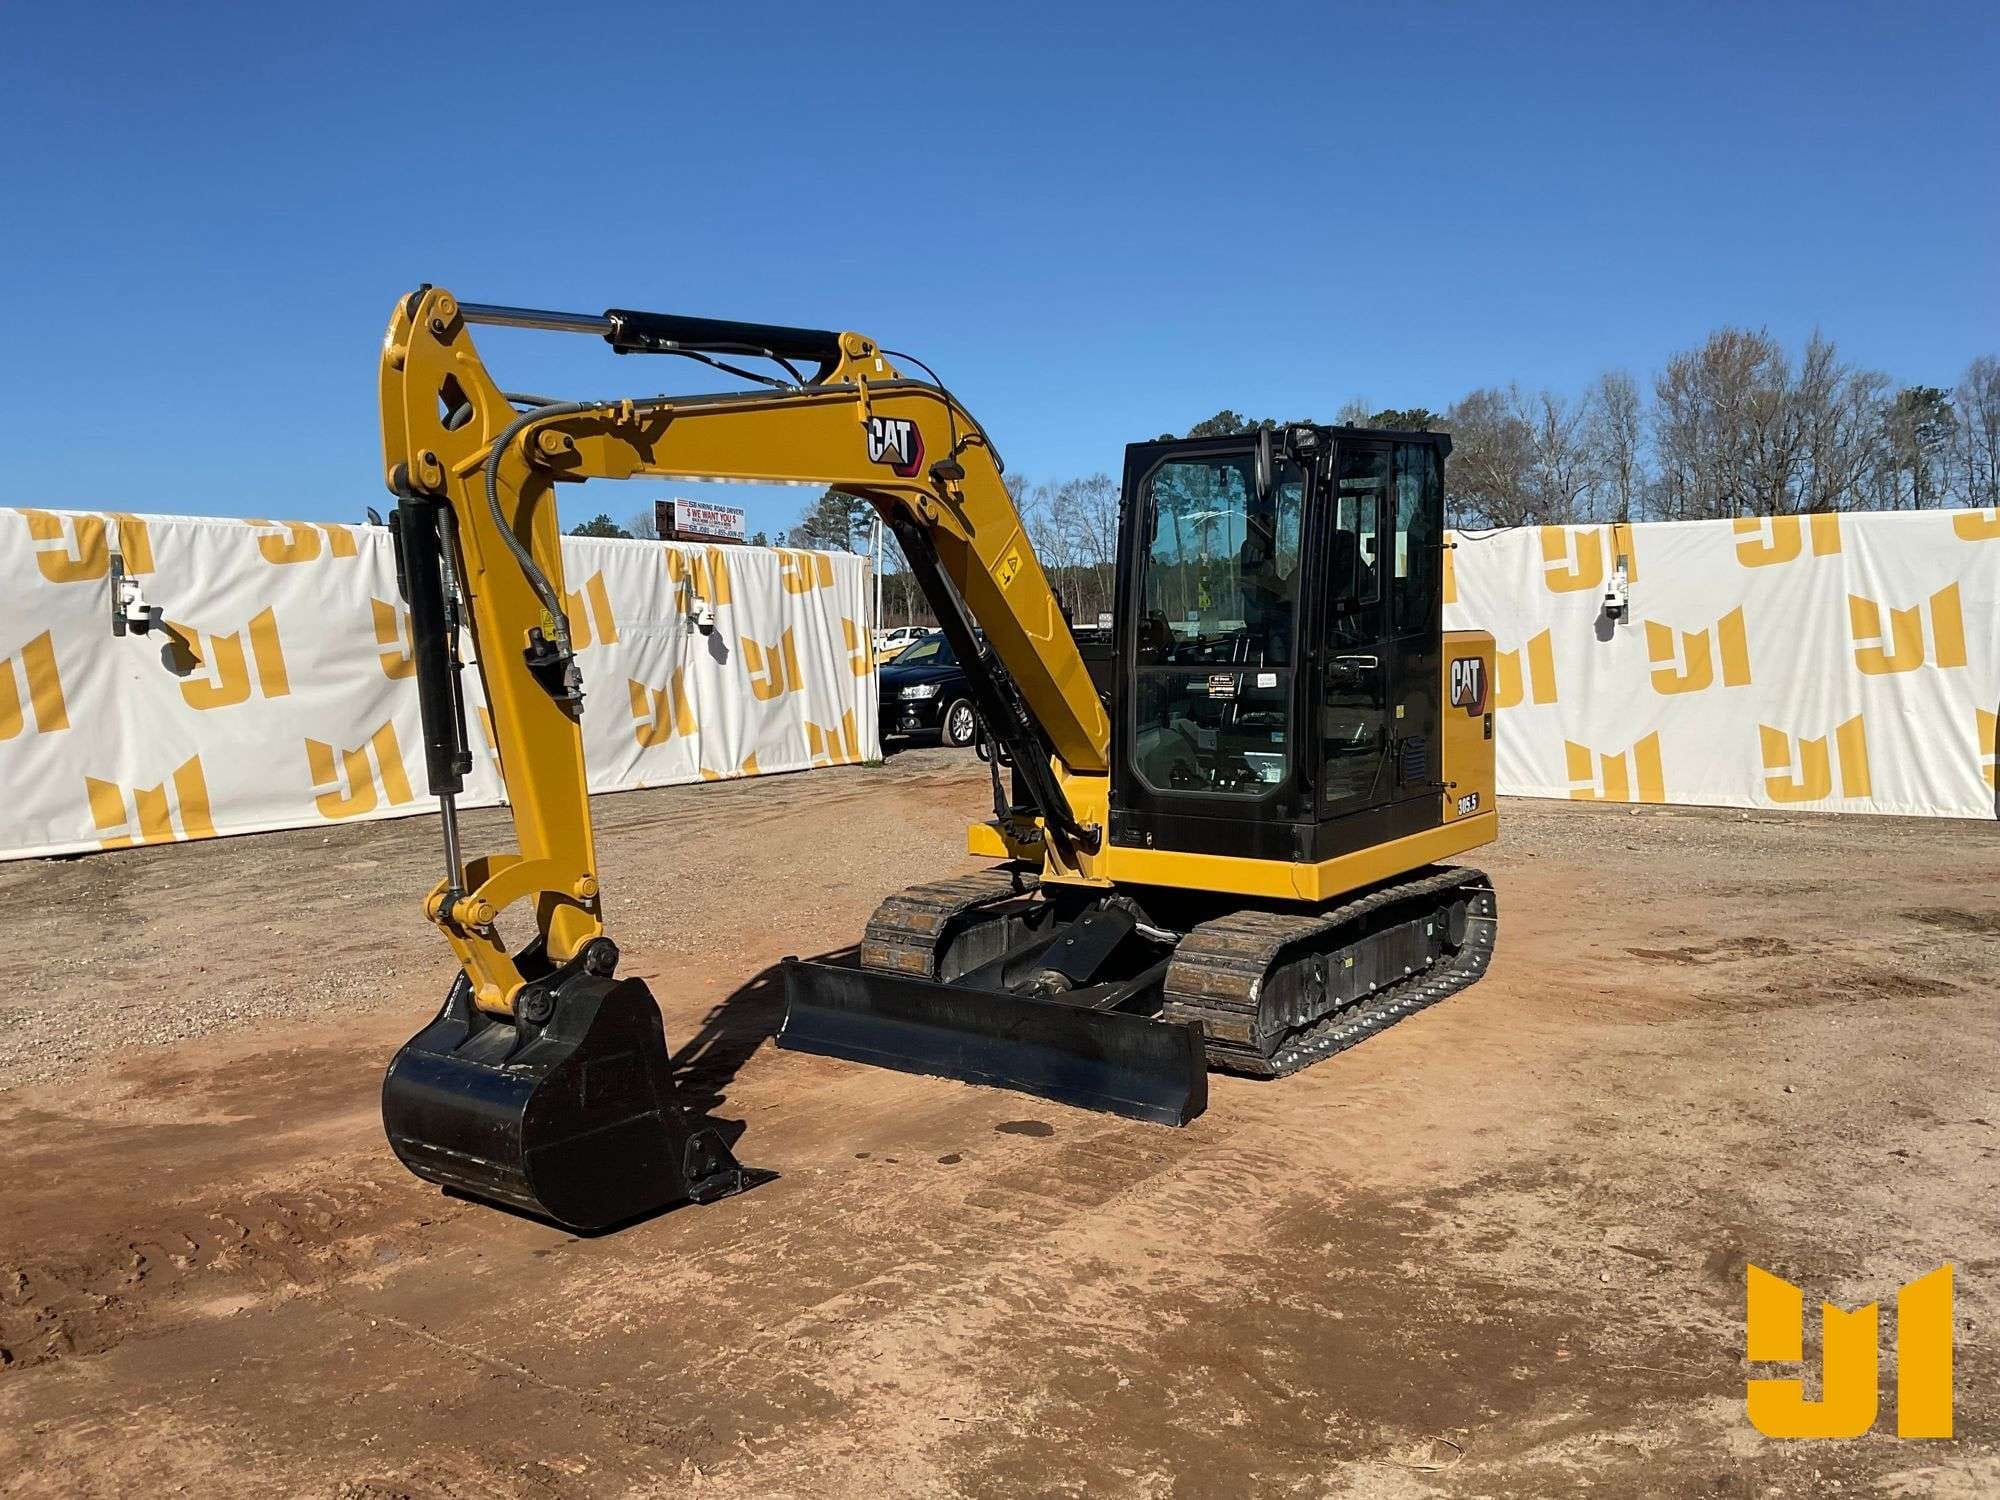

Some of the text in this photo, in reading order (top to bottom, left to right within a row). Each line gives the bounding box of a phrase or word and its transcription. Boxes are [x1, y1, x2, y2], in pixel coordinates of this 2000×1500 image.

[868, 417, 911, 464] CAT
[692, 509, 701, 518] WE
[702, 511, 718, 521] WANT
[720, 513, 732, 522] YOU
[1451, 659, 1480, 706] CAT
[1457, 793, 1478, 816] 305.5
